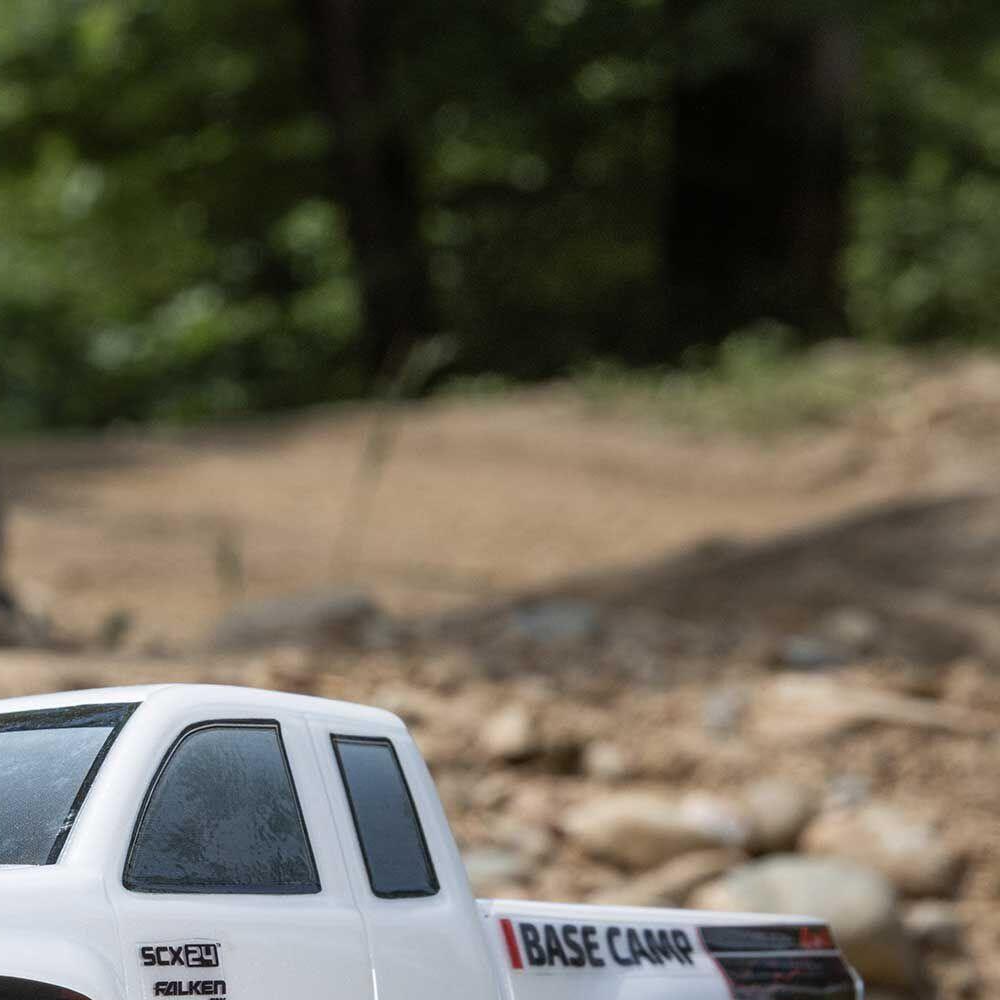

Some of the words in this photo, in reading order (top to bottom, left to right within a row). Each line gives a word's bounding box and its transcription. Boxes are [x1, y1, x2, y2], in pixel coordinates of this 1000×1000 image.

[141, 943, 219, 968] SCX24
[519, 922, 605, 968] BASE
[606, 925, 695, 967] CAMP
[154, 980, 227, 996] FALKEN
